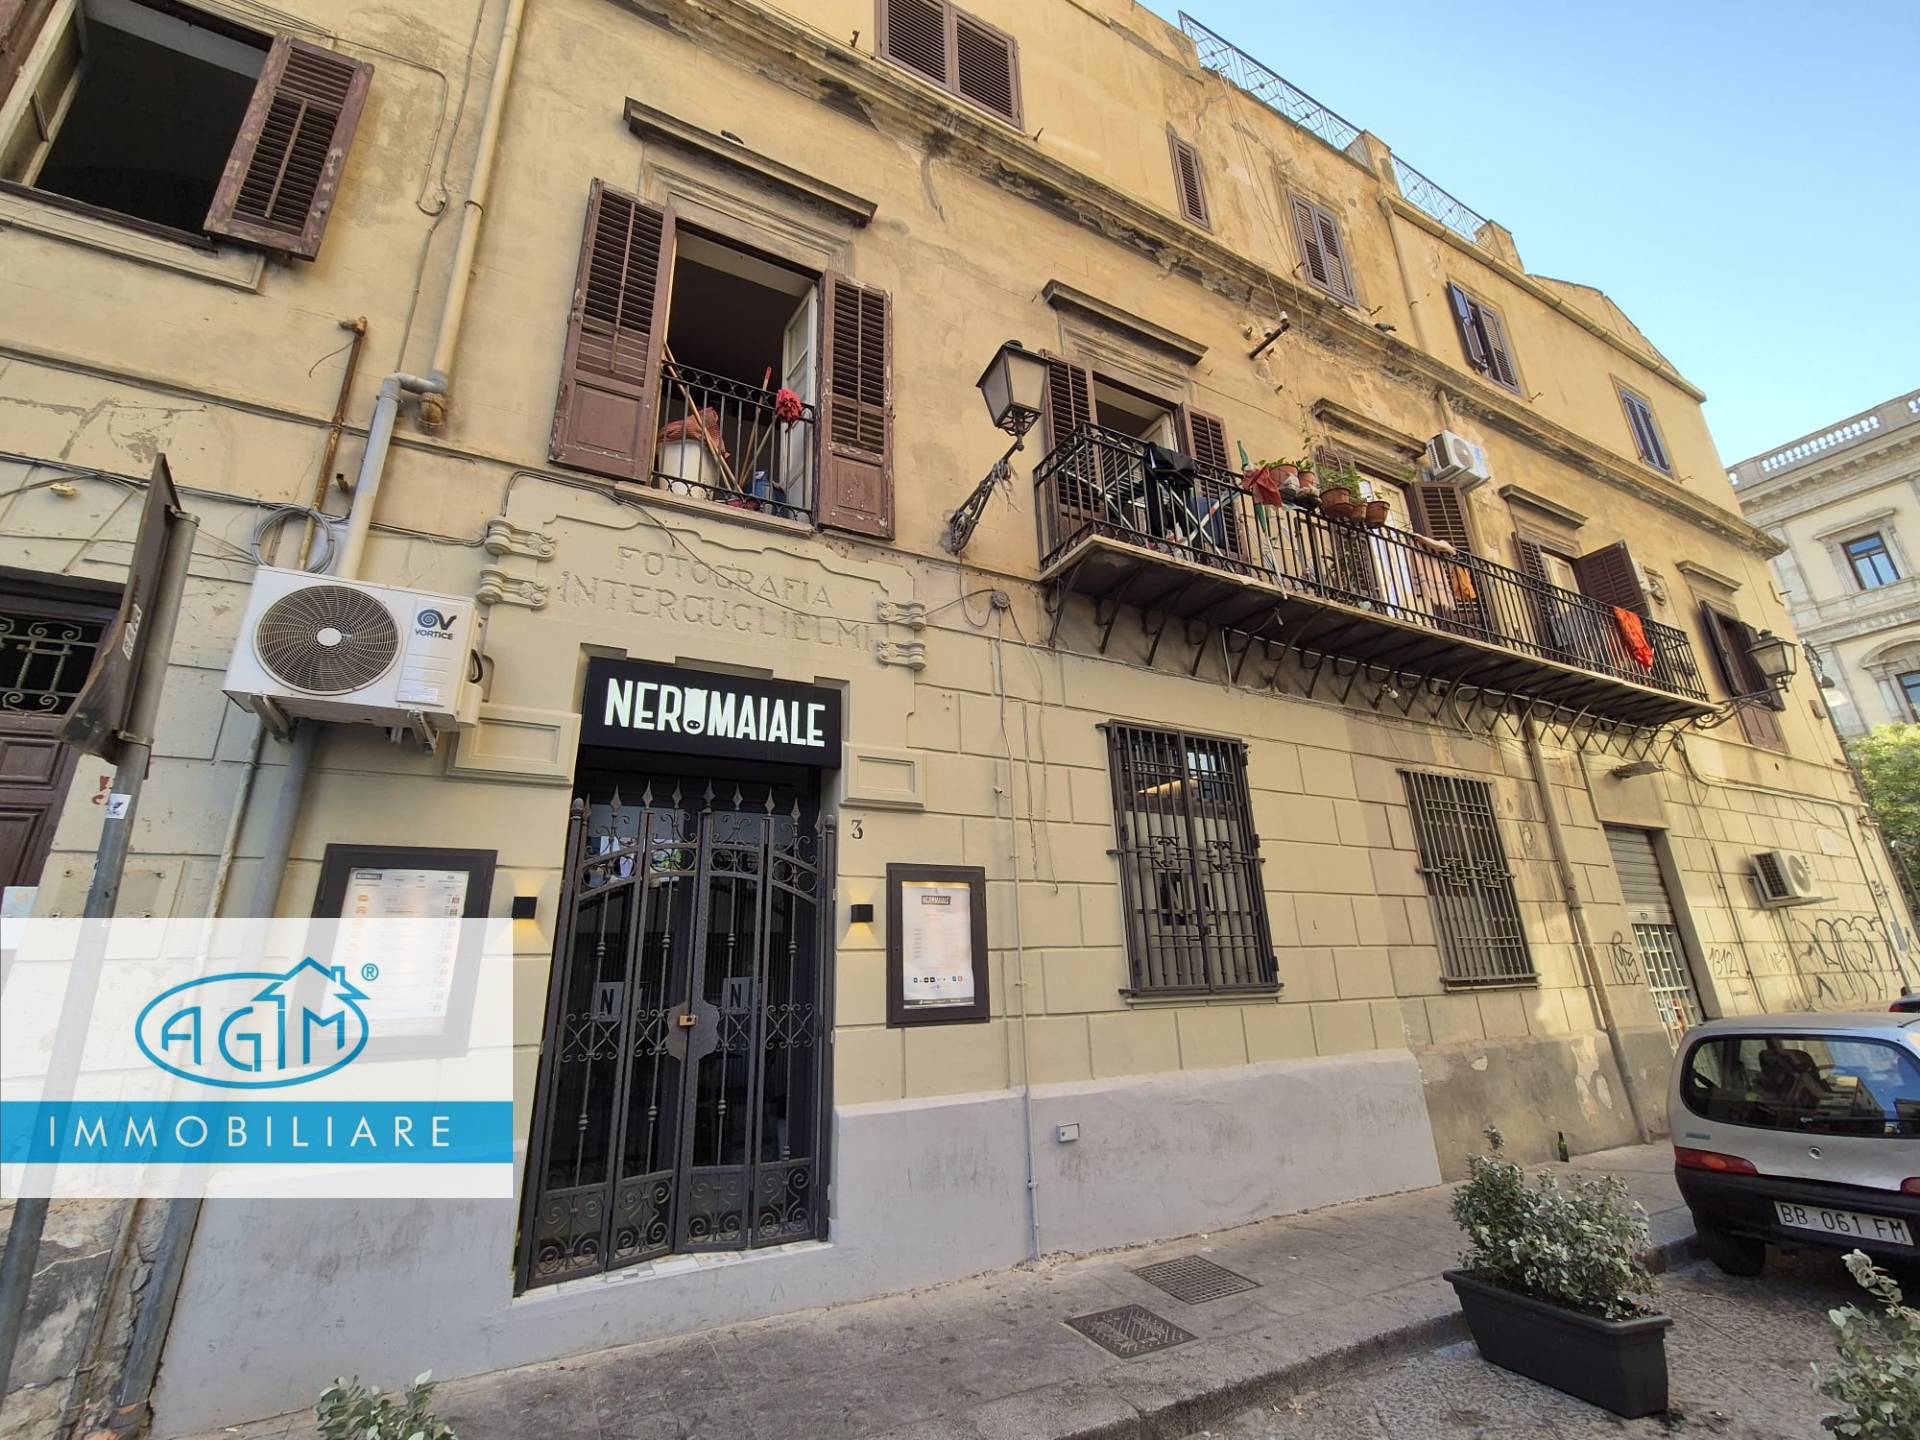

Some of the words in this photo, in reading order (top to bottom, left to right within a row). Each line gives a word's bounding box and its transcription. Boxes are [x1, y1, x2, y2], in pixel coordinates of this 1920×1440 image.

[615, 545, 833, 608] FOTOGRAFIA
[415, 628, 454, 641] VORTICE
[851, 818, 864, 840] 3
[600, 988, 615, 1017] N
[730, 983, 743, 1009] N
[1780, 1204, 1809, 1225] BB
[1820, 1210, 1863, 1235] 061
[1872, 1218, 1908, 1243] FM
